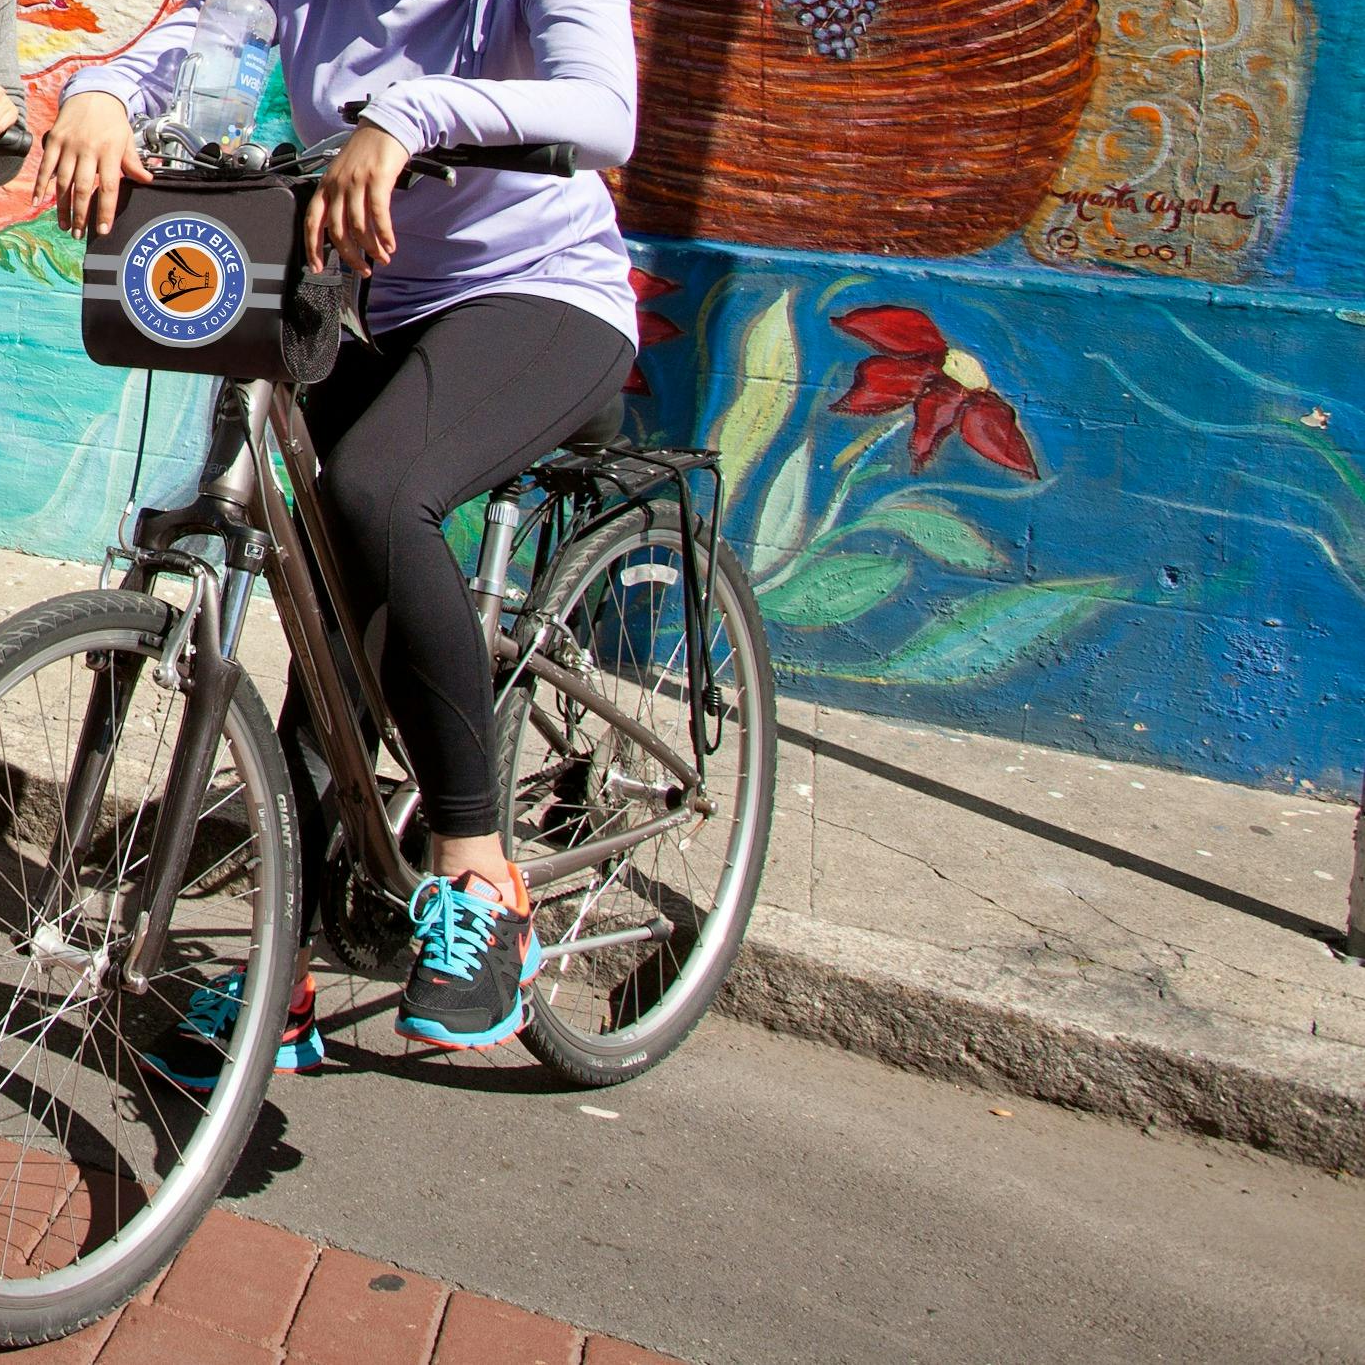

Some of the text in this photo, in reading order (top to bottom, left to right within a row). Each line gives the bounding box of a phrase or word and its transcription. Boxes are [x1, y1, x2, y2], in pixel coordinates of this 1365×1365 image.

[132, 224, 240, 273] BAY CITY BIKE
[131, 288, 237, 334] RENTALS & TOURS
[276, 793, 292, 848] GIANT
